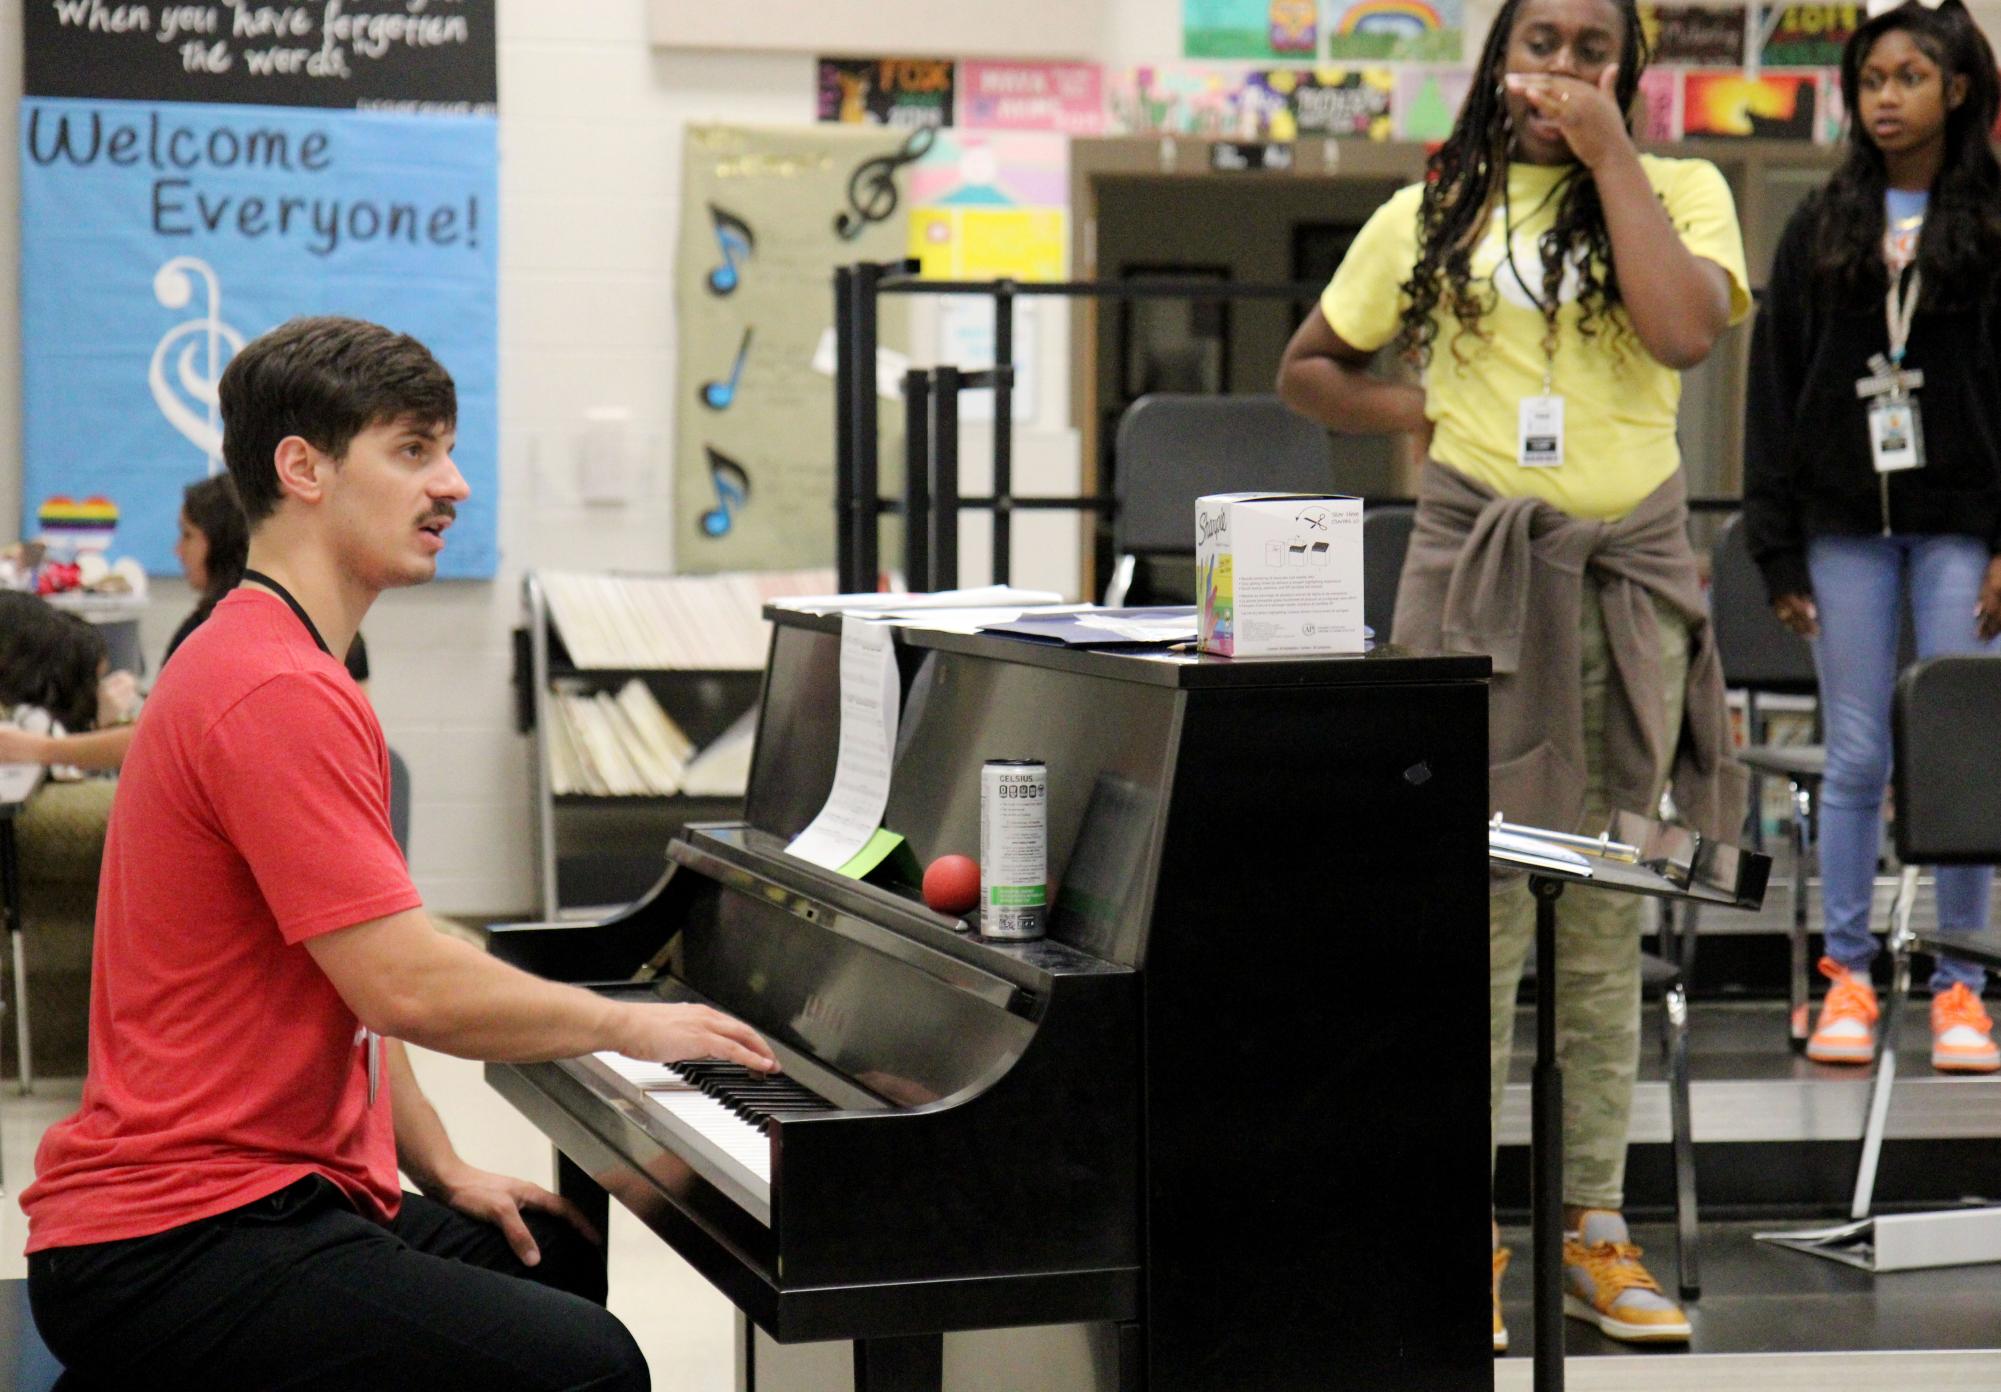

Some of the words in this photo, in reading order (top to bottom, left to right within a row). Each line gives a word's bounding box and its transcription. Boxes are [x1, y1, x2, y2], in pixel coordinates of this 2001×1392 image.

[156, 5, 218, 43] you
[232, 0, 313, 38] have
[179, 40, 233, 74] the
[27, 107, 331, 170] Welcome
[151, 178, 479, 257] Everyone!
[999, 774, 1033, 783] CELSIUS
